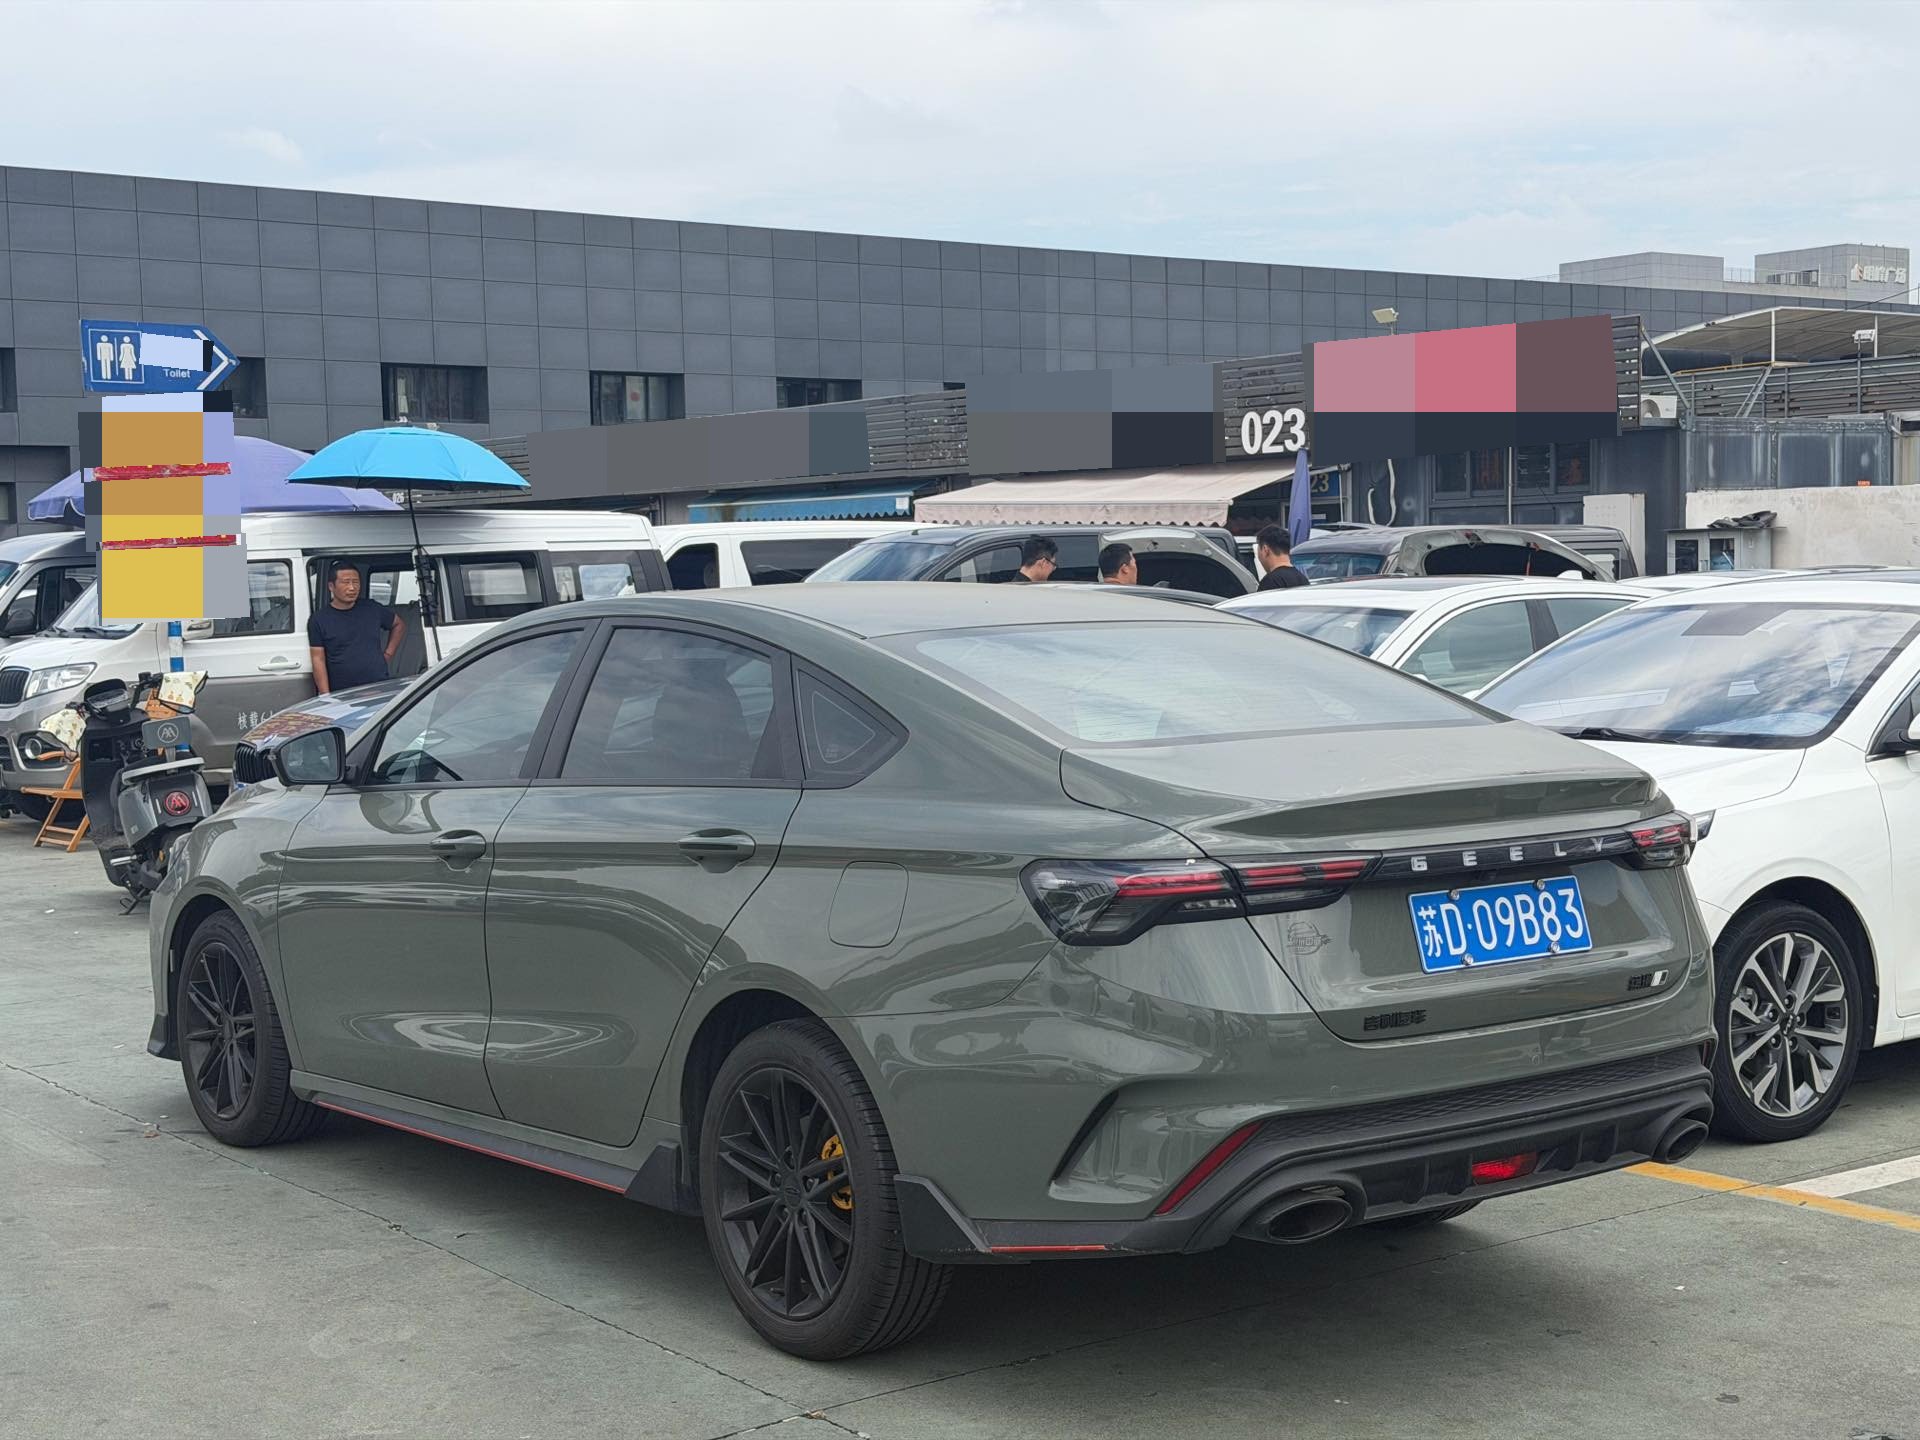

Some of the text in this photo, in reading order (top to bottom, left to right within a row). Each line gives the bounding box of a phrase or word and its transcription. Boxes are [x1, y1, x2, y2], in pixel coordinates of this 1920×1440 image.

[162, 368, 190, 378] Toilet
[1241, 408, 1305, 454] 023
[1411, 837, 1604, 871] GEELY
